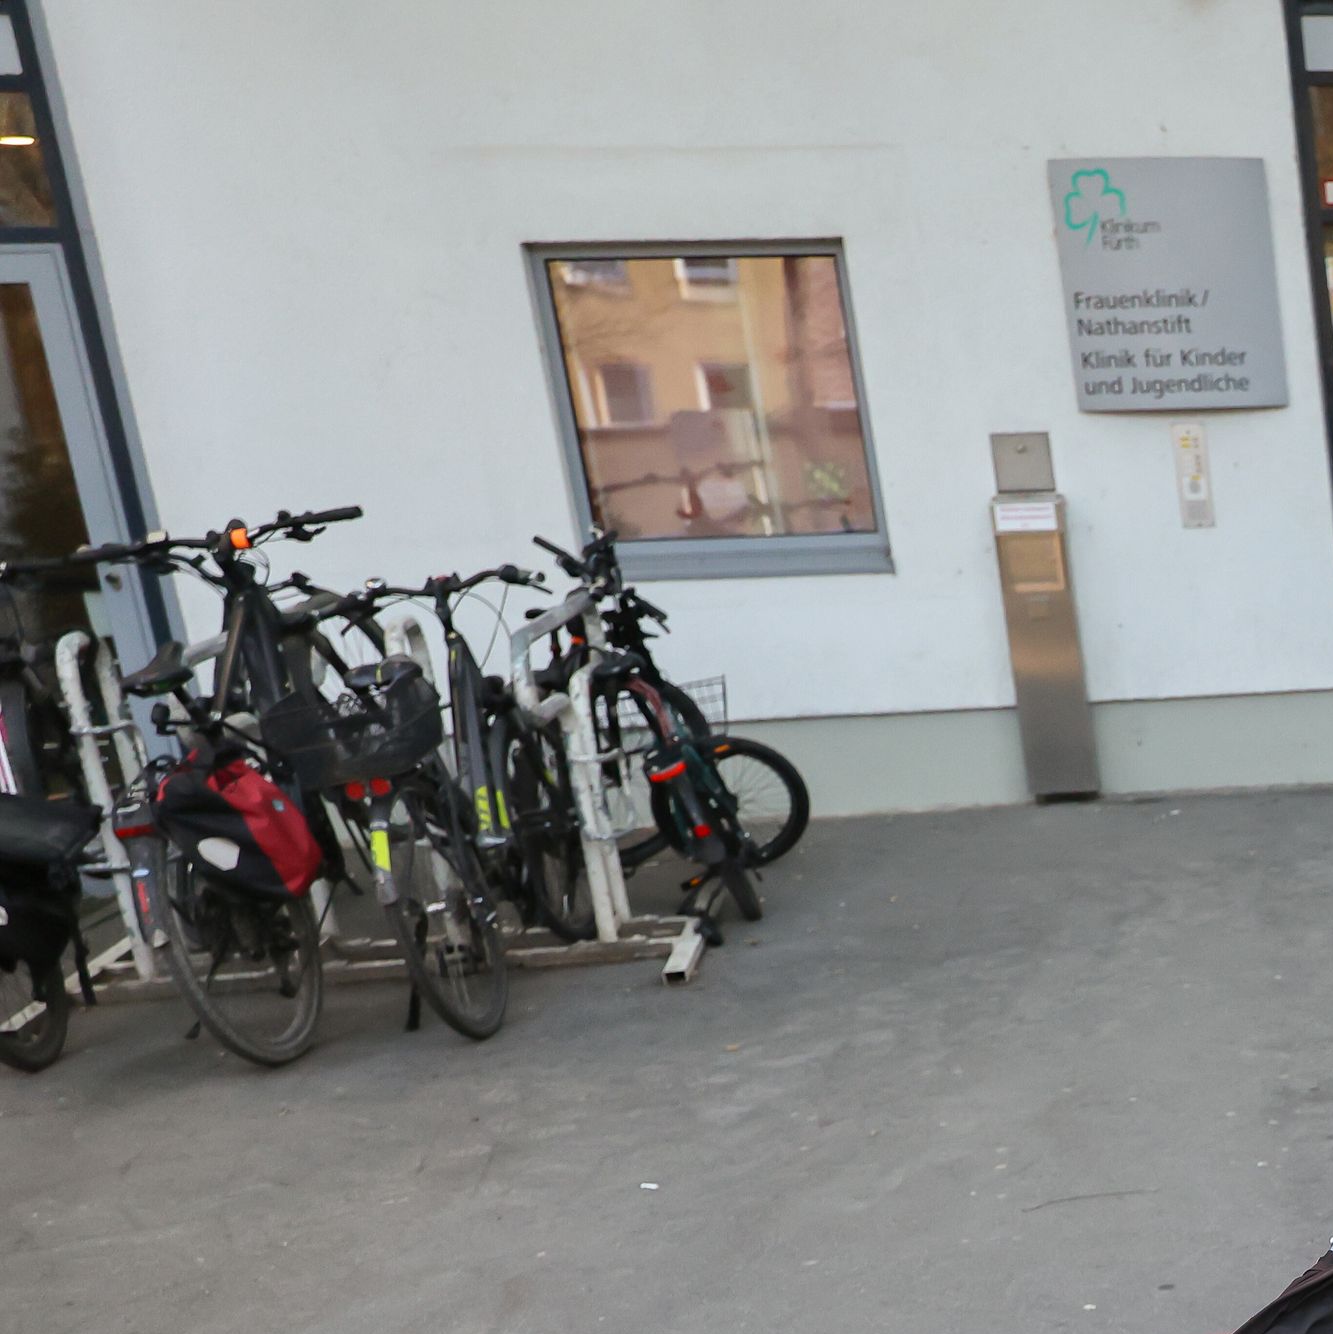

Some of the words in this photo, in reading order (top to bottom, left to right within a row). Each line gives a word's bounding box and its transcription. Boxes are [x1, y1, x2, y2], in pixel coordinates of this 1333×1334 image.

[1077, 315, 1192, 337] Nathanstift
[1081, 349, 1137, 369] Klinik
[1144, 347, 1172, 368] für
[1180, 346, 1247, 367] Kinder
[1084, 376, 1123, 395] und
[1131, 373, 1250, 399] Jugendliche
